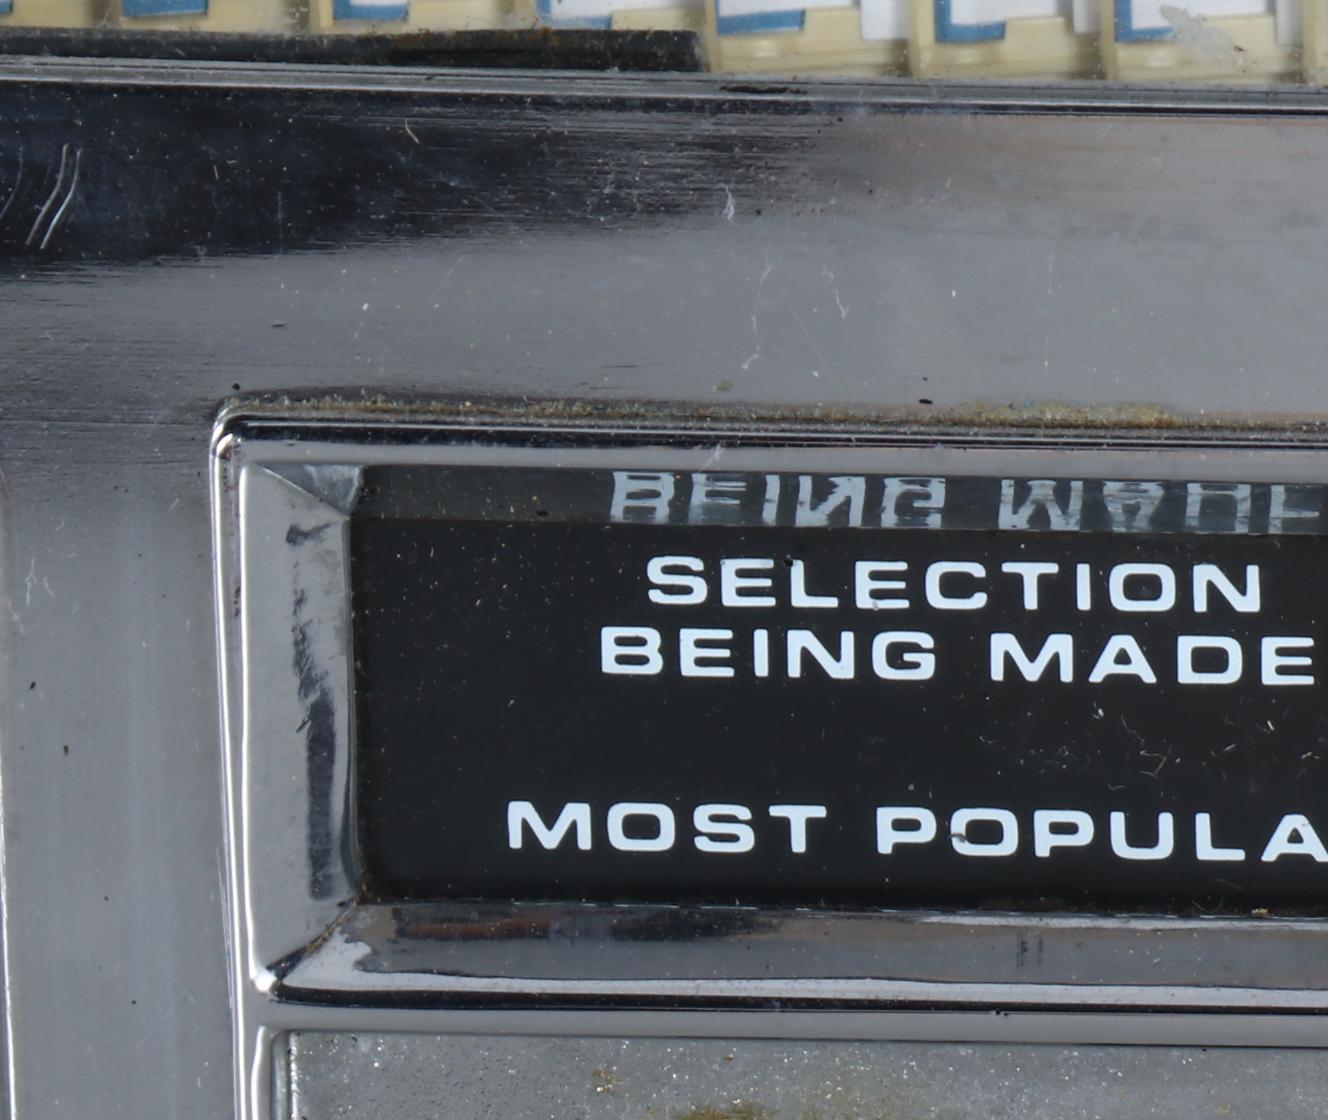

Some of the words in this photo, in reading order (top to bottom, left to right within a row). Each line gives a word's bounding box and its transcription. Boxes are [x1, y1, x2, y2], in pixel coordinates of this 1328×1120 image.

[647, 556, 1260, 613] SELECTION
[601, 627, 935, 681] BEING
[991, 633, 1314, 686] MADE
[507, 800, 827, 854] MOST
